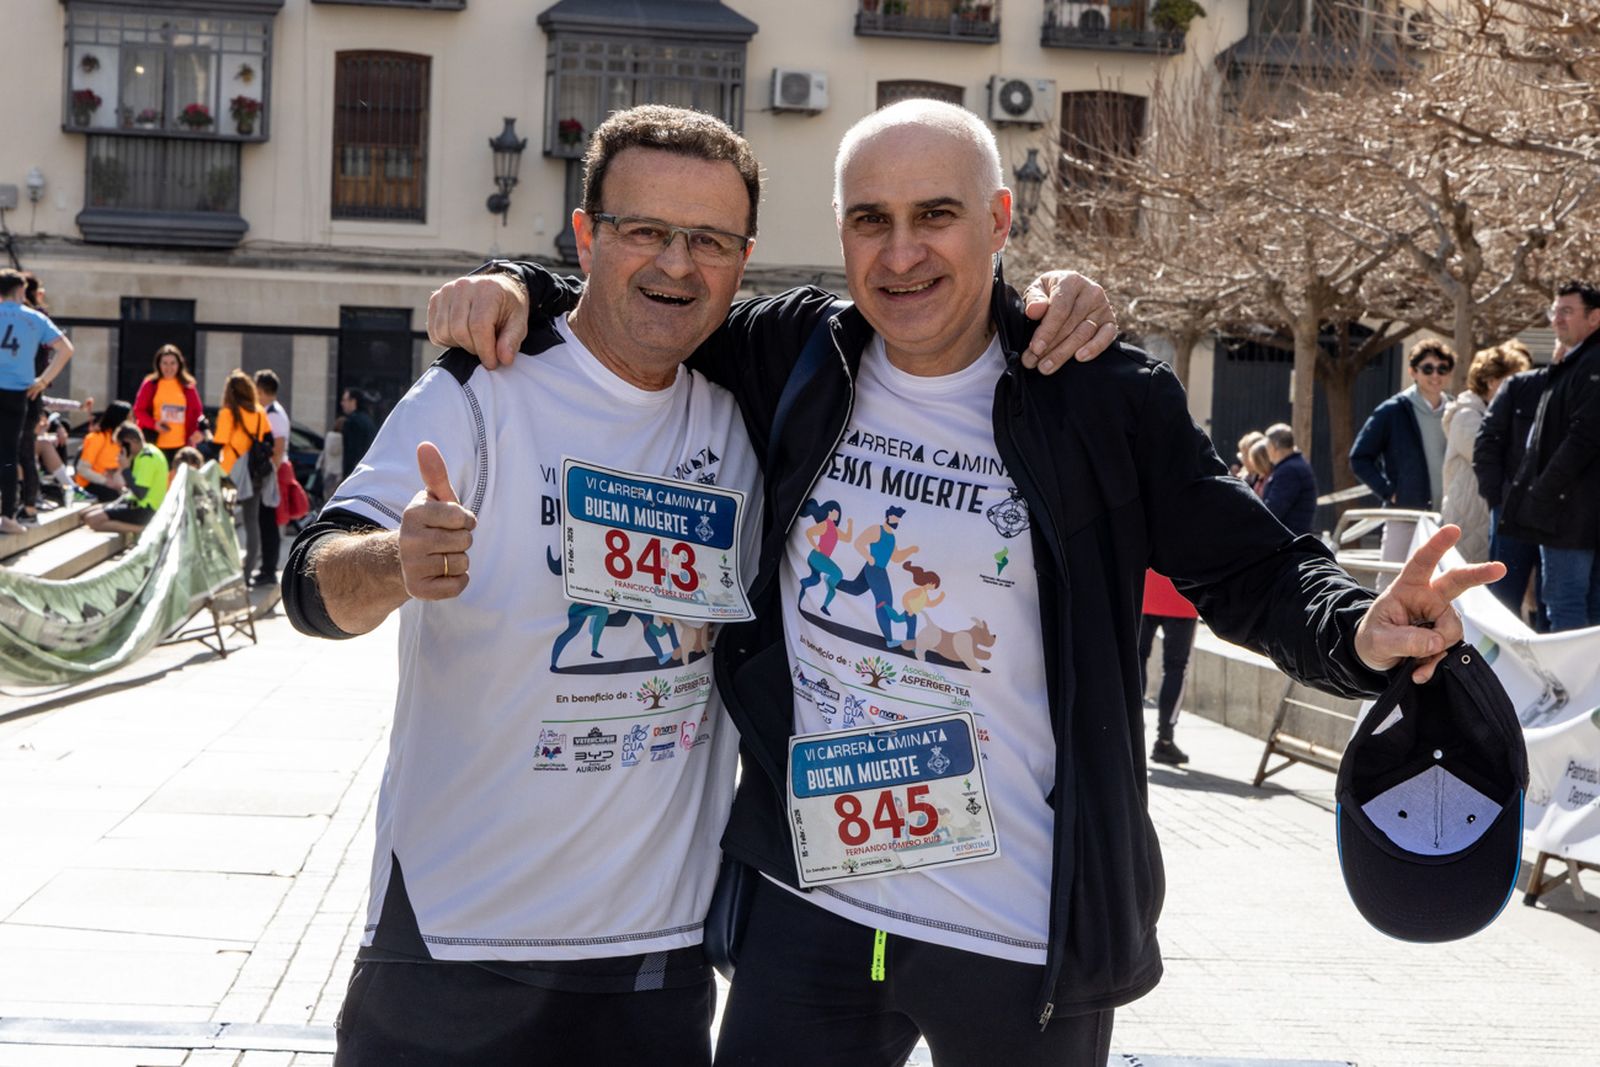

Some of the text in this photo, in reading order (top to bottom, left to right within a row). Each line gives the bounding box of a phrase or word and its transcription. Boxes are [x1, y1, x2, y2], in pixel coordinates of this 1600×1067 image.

[1, 324, 20, 357] 4
[540, 464, 556, 485] VI
[933, 449, 1010, 477] CAMIN
[585, 476, 717, 514] VI CARRERA CAMINATA
[881, 466, 988, 514] MUERTE
[585, 497, 689, 535] BUENA MUERTE
[604, 529, 699, 592] 843
[615, 580, 657, 594] FRANCISCO
[556, 695, 569, 704] En
[571, 693, 614, 704] beneficio
[616, 691, 628, 700] de
[900, 674, 971, 698] ASPERGER-TEA
[575, 750, 614, 760] BYD
[622, 742, 645, 752] CUA
[622, 752, 637, 761] LIA
[804, 728, 947, 761] VI CARRERA CAMINATA
[576, 764, 612, 774] AURINGIS
[807, 755, 920, 790] BUENA MUERTE
[834, 785, 939, 846] 845
[845, 844, 888, 856] FERNANDO
